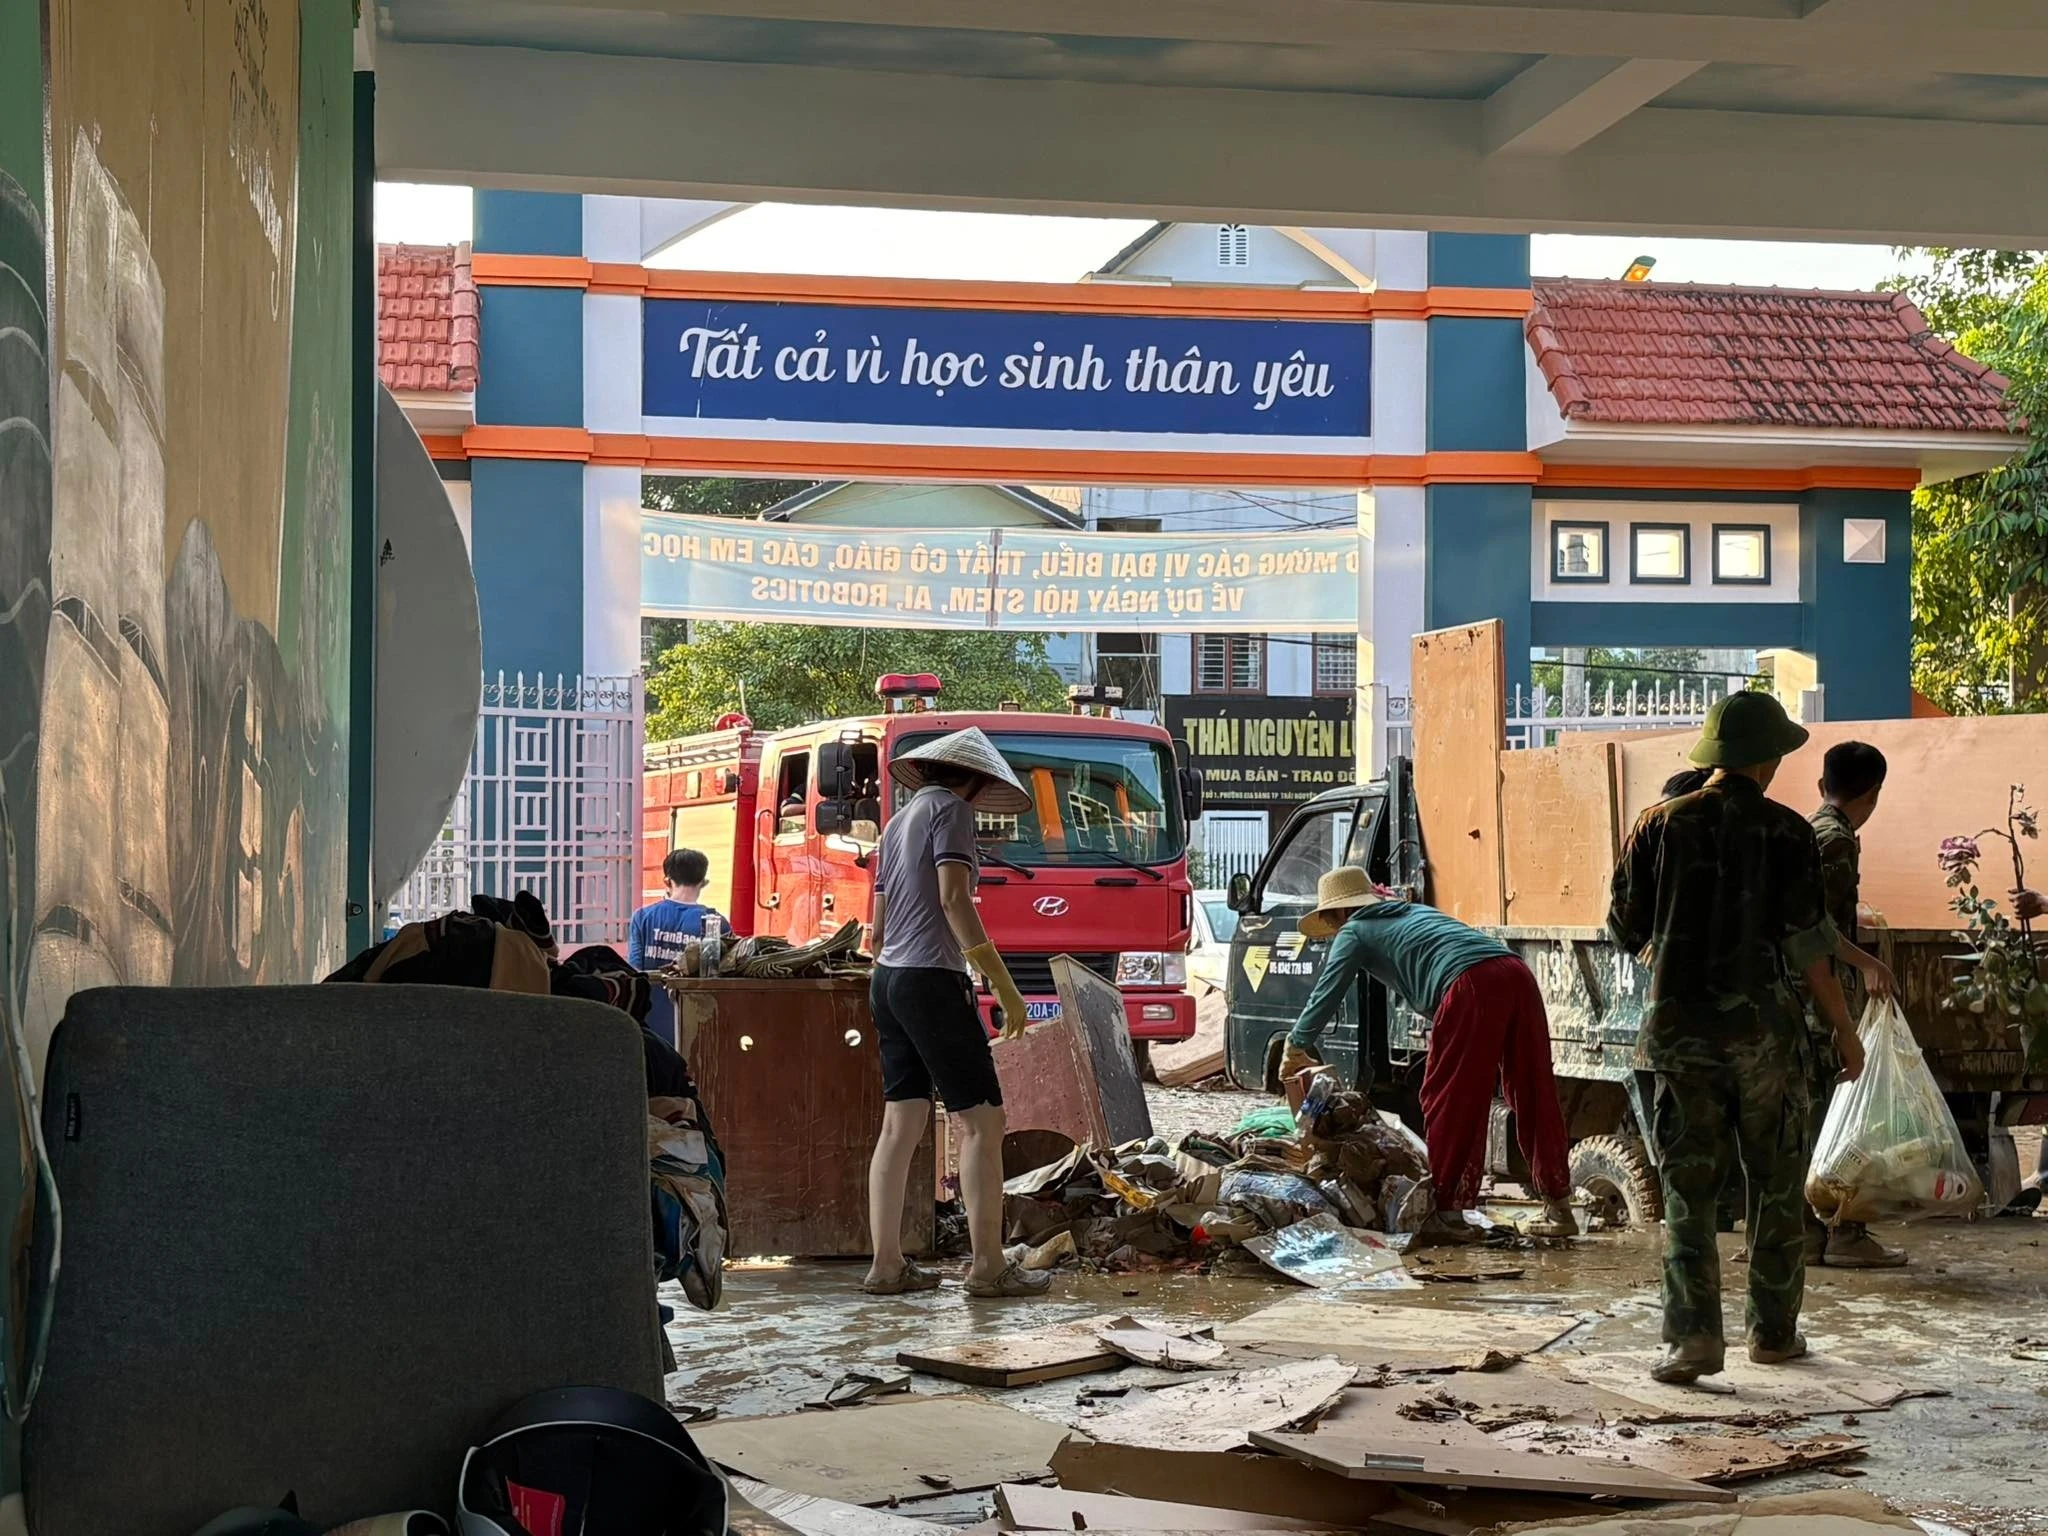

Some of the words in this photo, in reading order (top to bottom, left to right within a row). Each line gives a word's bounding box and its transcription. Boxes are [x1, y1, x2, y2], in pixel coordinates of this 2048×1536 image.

[679, 323, 763, 380] Tất
[774, 329, 836, 382] cả
[846, 335, 889, 383] vì
[900, 338, 988, 397] học
[999, 341, 1111, 391] sinh
[1125, 345, 1239, 395] thân
[1253, 350, 1333, 410] yêu
[1183, 709, 1239, 756] THÁI
[1243, 709, 1335, 758] NGUYÊN
[1206, 768, 1242, 782] MUA
[1245, 766, 1279, 782] BÁN
[1291, 769, 1334, 783] TRAO
